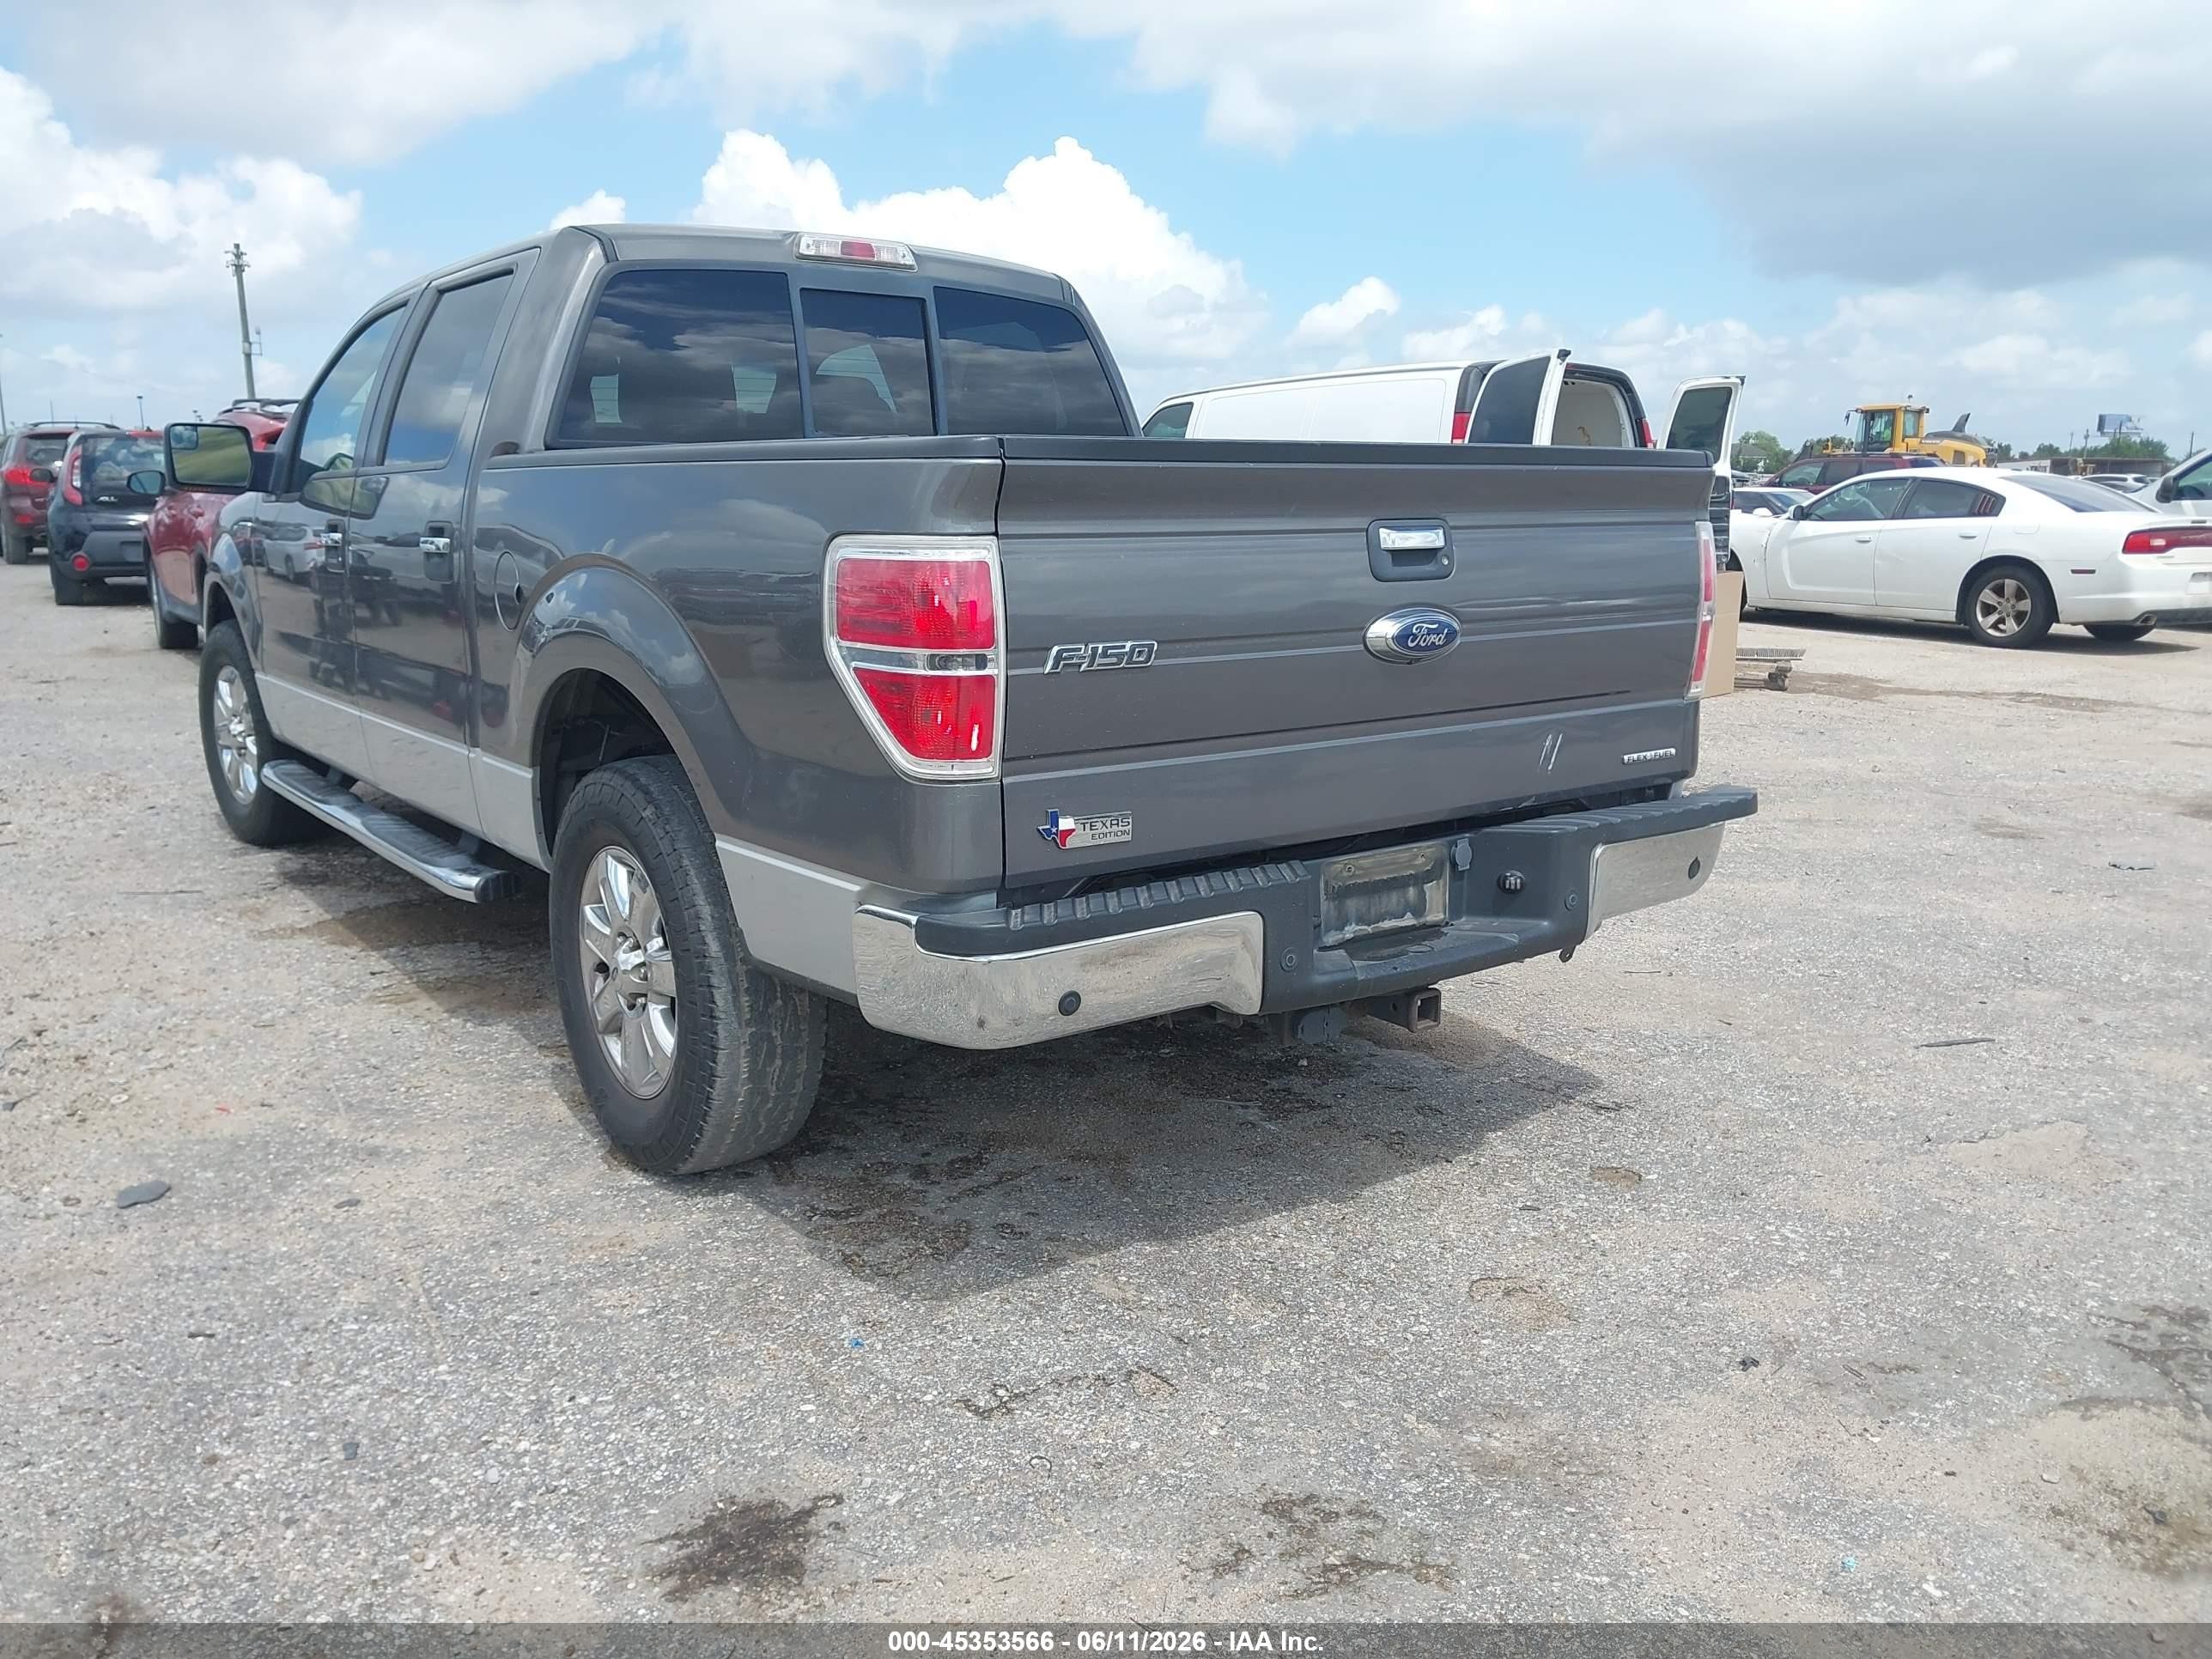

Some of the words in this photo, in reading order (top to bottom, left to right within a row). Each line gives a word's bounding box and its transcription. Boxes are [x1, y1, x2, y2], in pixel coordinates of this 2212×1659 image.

[1408, 623, 1449, 647] Ford
[1044, 641, 1158, 674] F-150
[1627, 754, 1648, 763] FLEX
[1654, 750, 1674, 758] FUEL
[1080, 817, 1131, 832] TEXAS
[1091, 829, 1130, 841] EDITION
